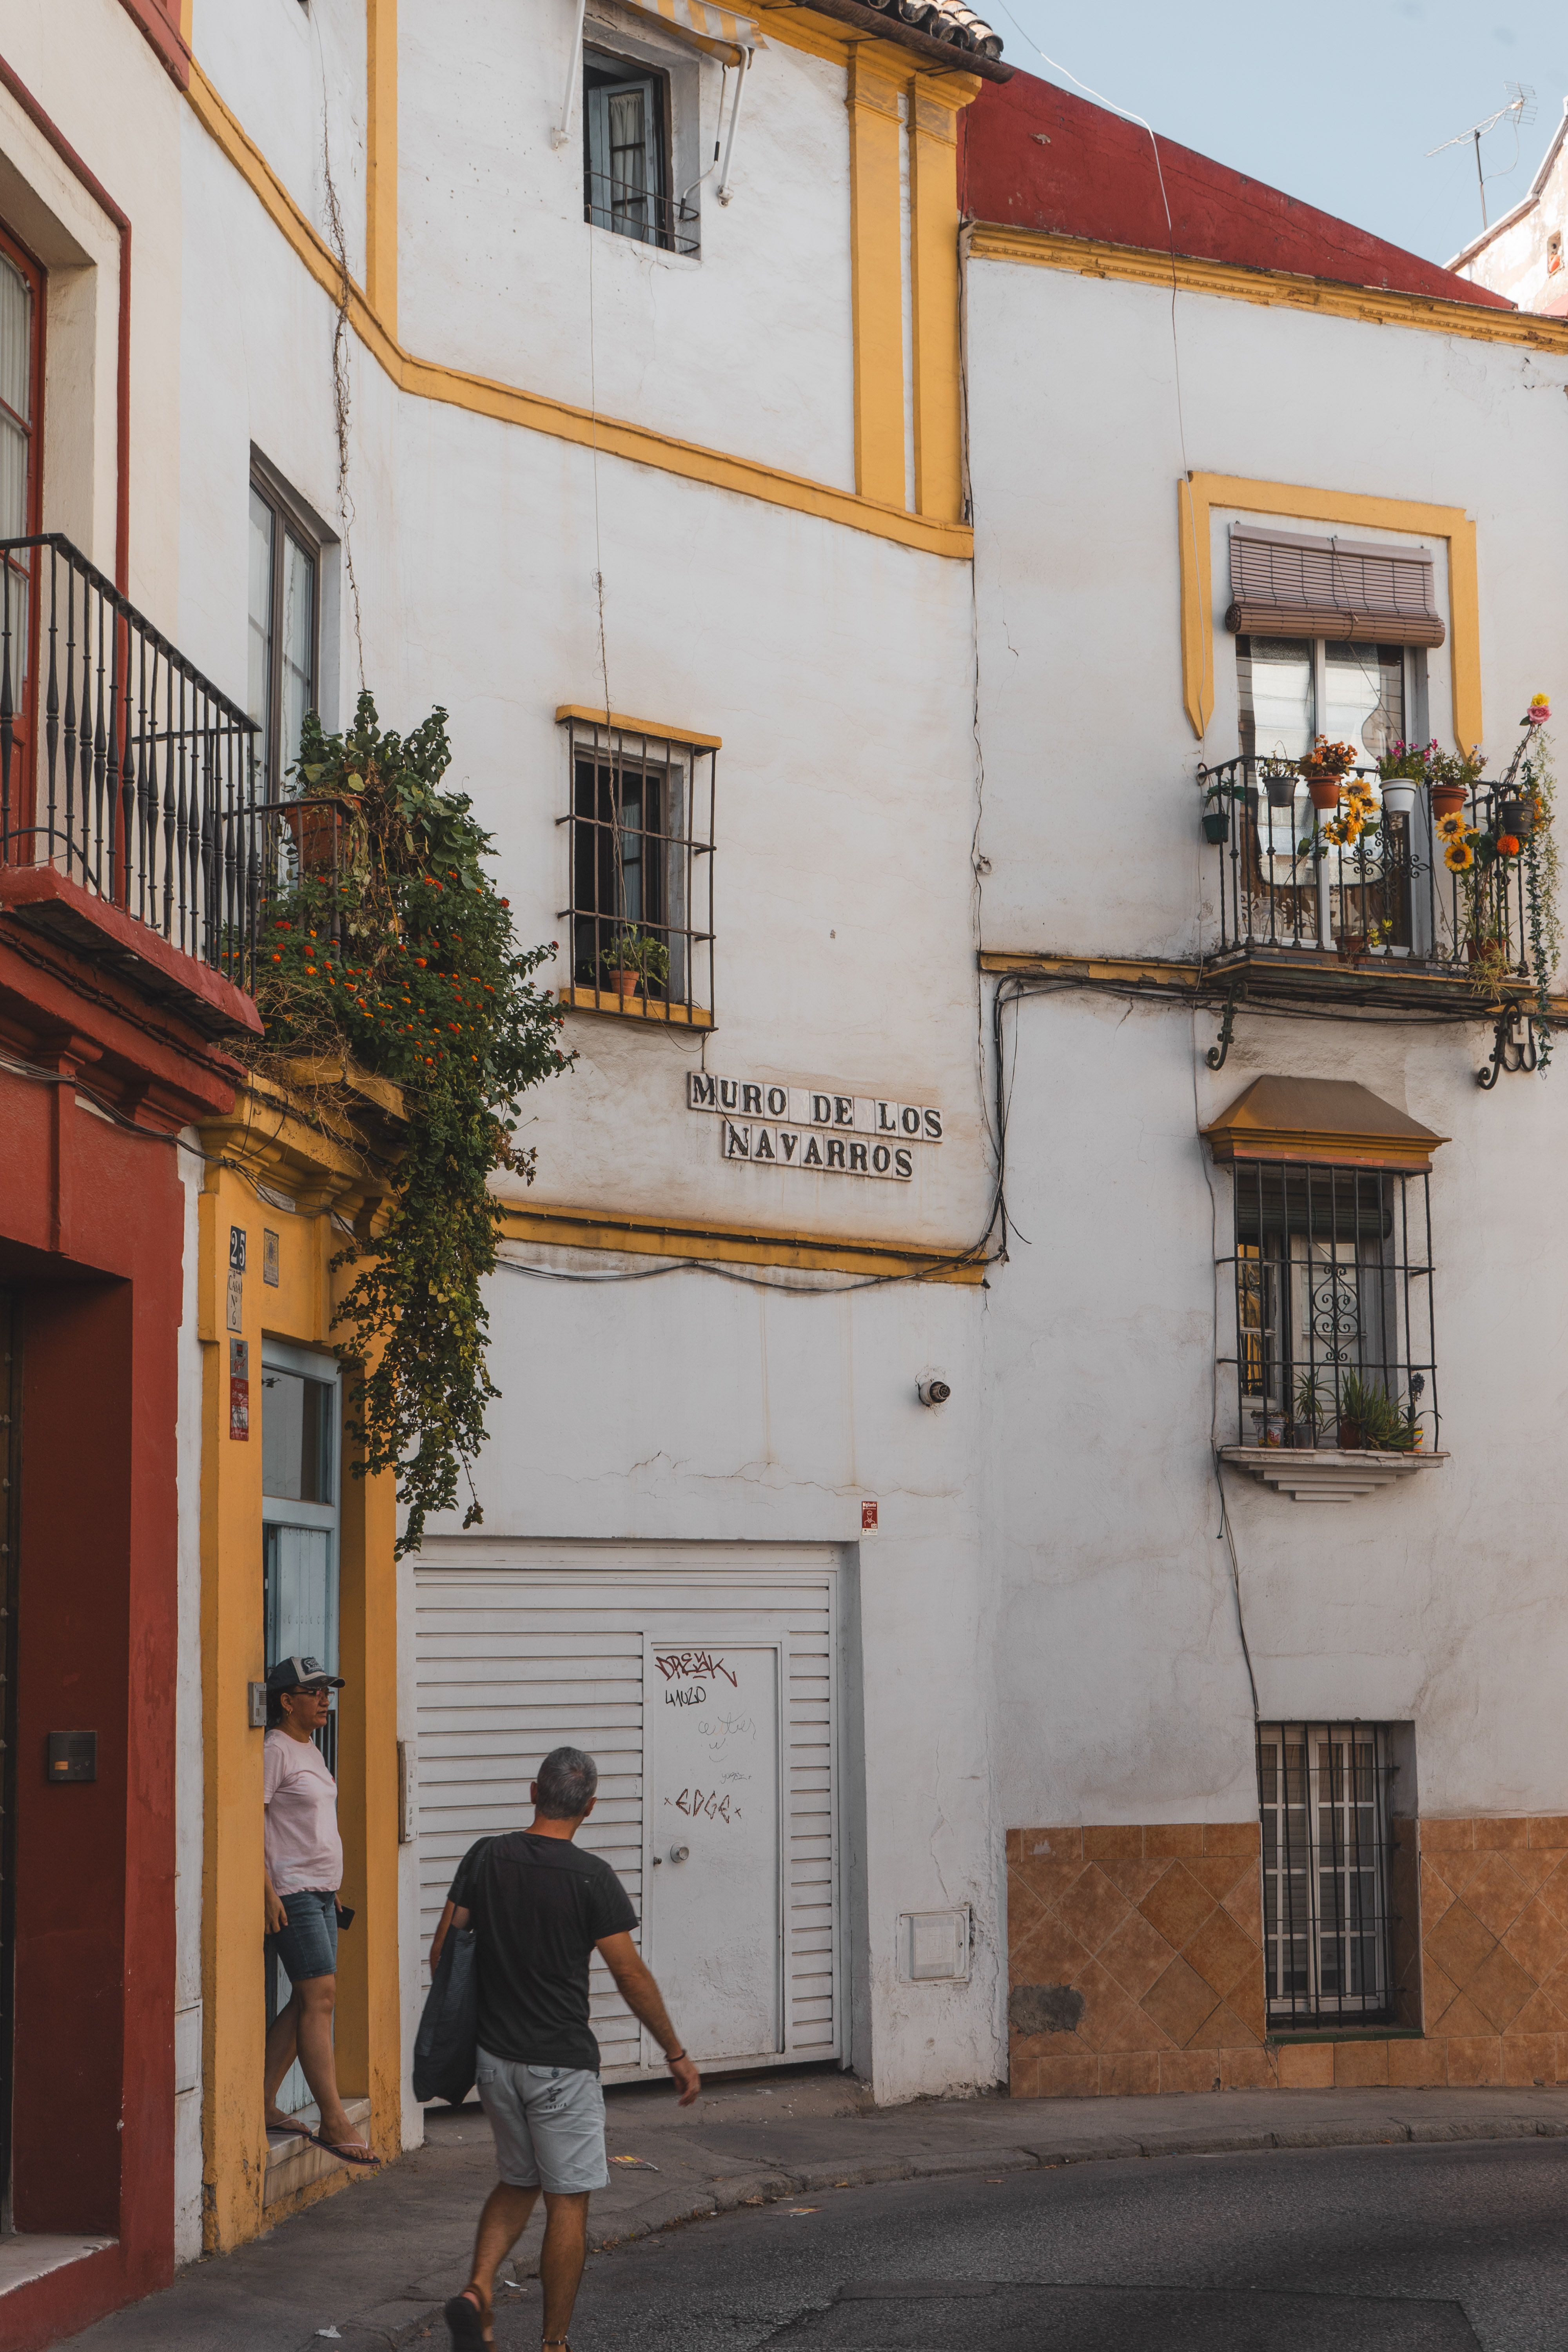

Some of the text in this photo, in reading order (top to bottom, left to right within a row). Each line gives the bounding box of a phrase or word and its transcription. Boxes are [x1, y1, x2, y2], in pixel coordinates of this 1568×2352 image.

[693, 1075, 942, 1138] MURO DE LOS
[728, 1125, 913, 1177] NAVARROS
[230, 1230, 245, 1267] 25
[232, 1311, 236, 1325] 6
